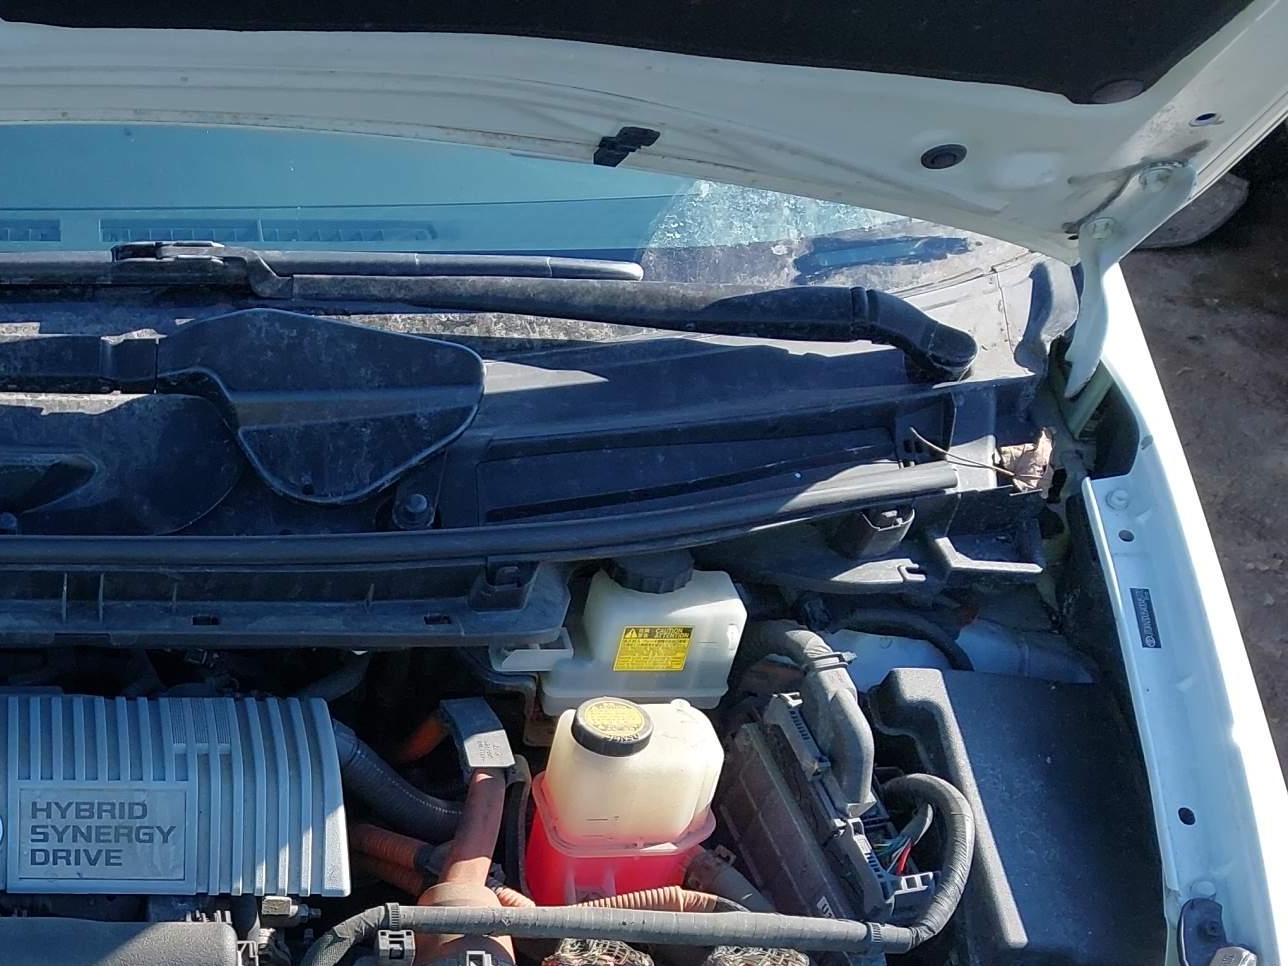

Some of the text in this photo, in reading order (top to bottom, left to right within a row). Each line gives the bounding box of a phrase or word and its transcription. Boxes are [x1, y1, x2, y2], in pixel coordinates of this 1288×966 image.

[31, 801, 148, 820] HYBRID
[30, 825, 176, 844] SYNERGY
[30, 848, 123, 866] DRIVE
